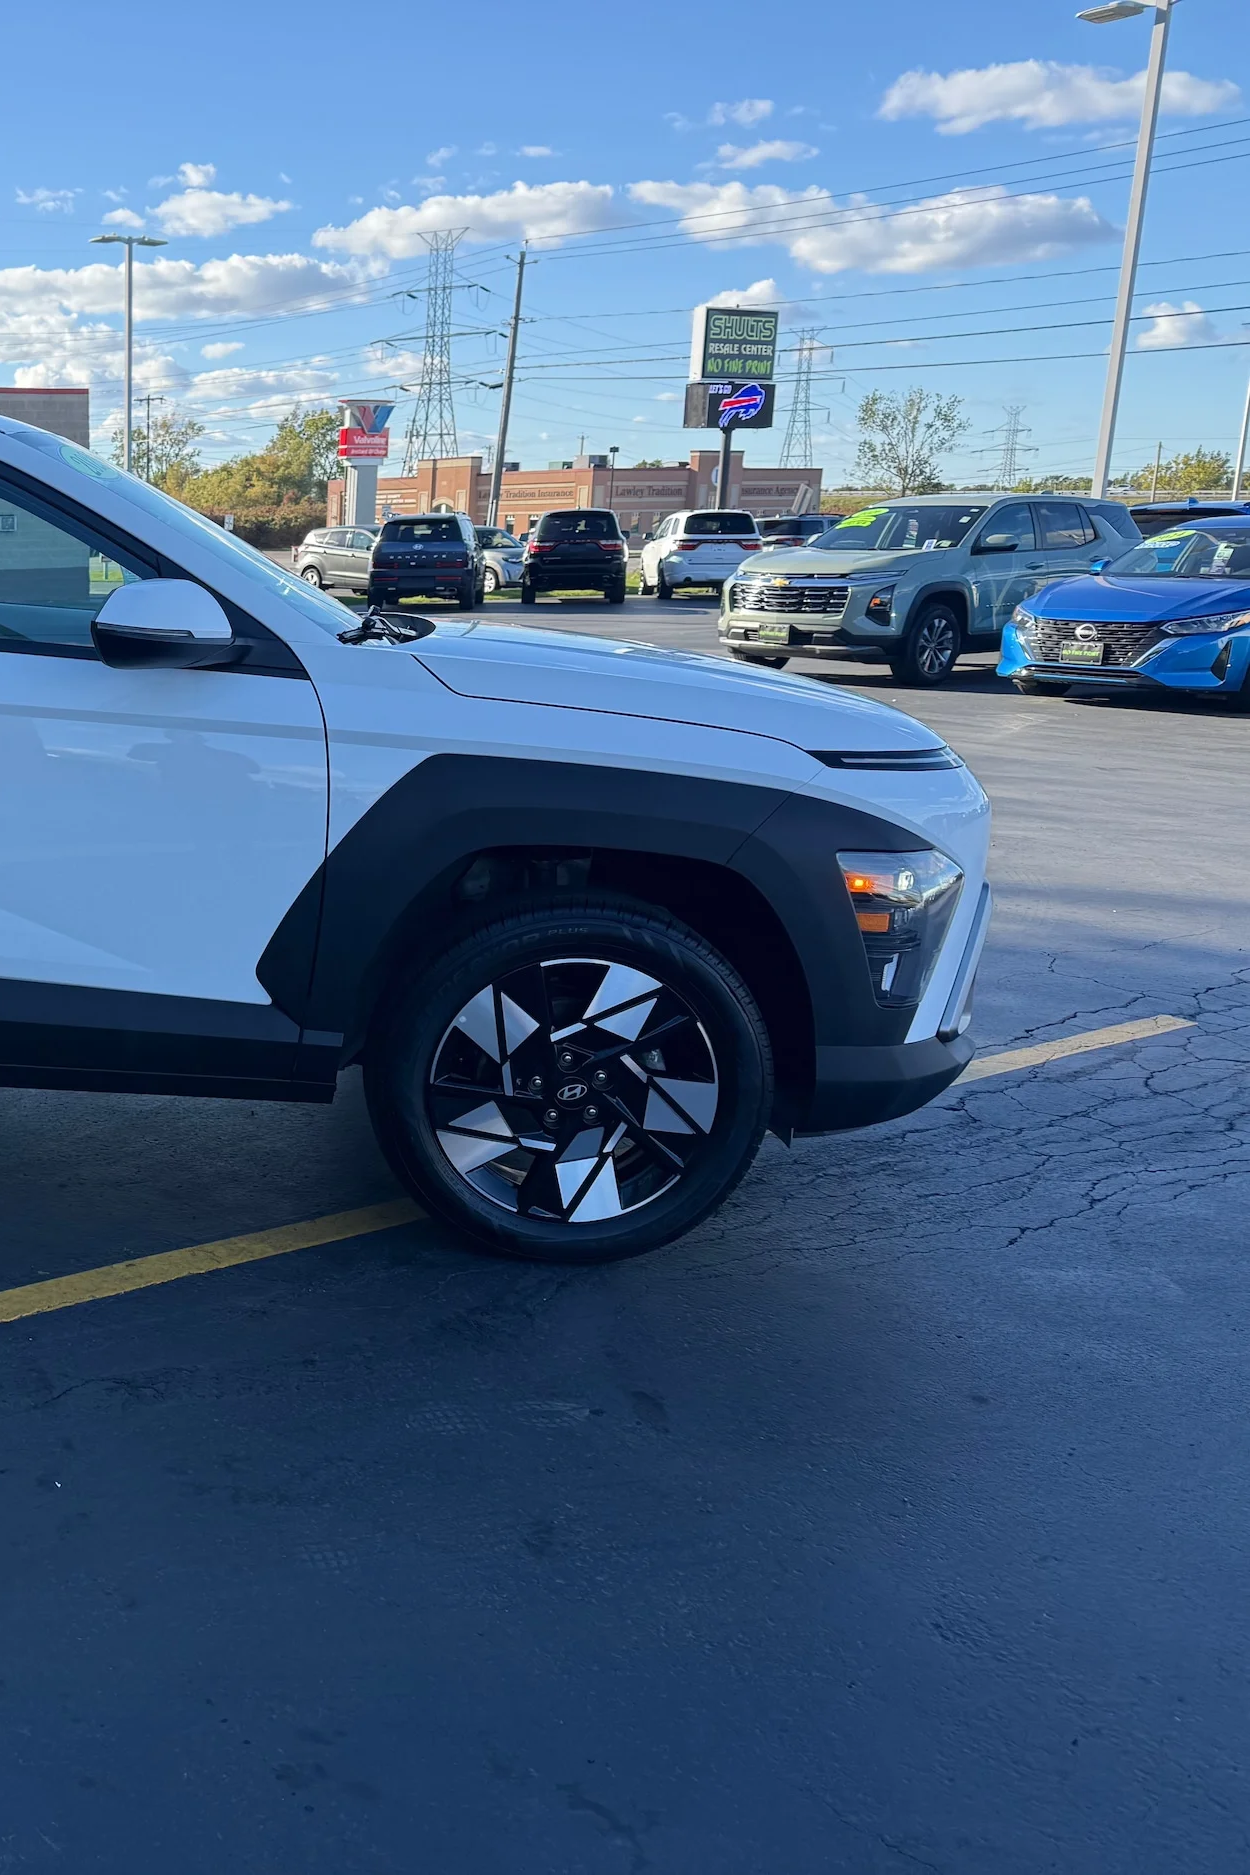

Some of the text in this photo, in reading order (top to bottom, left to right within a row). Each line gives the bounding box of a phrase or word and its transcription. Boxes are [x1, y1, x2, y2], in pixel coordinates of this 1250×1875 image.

[710, 315, 775, 340] SHULTS
[708, 342, 773, 356] RESALE CENTER
[707, 357, 772, 375] NO FINE PRINT
[505, 489, 536, 498] Tradition
[537, 489, 574, 498] Insurance
[615, 485, 683, 498] Lawley Tradition
[547, 926, 590, 936] PLUS
